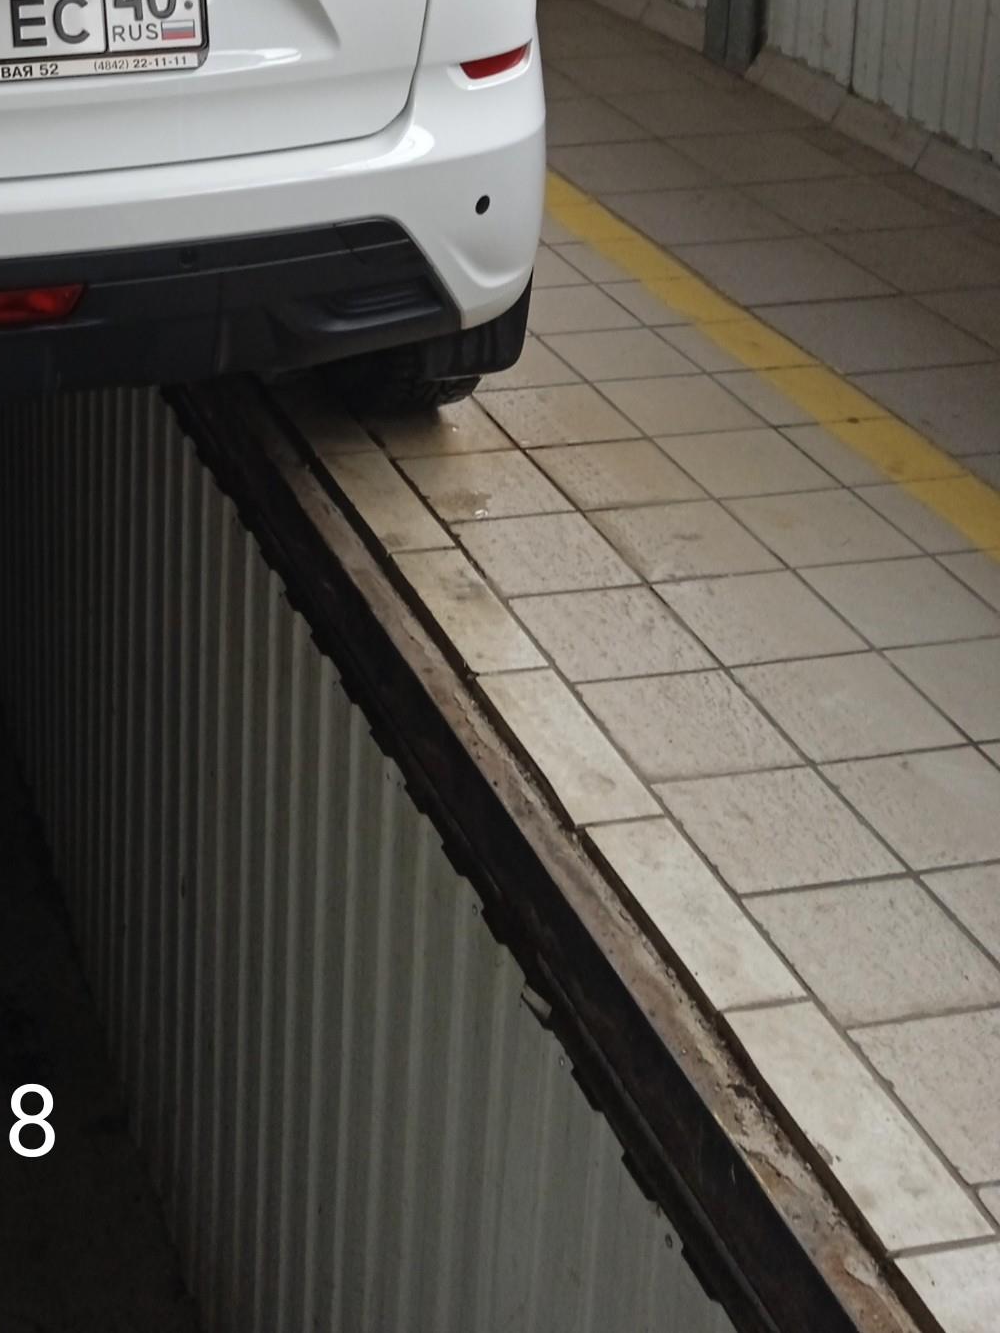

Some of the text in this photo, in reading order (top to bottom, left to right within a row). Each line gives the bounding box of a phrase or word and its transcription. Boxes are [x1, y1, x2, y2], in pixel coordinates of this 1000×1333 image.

[111, 22, 160, 43] RUS
[39, 63, 60, 76] 52
[132, 55, 188, 69] 22-11-11
